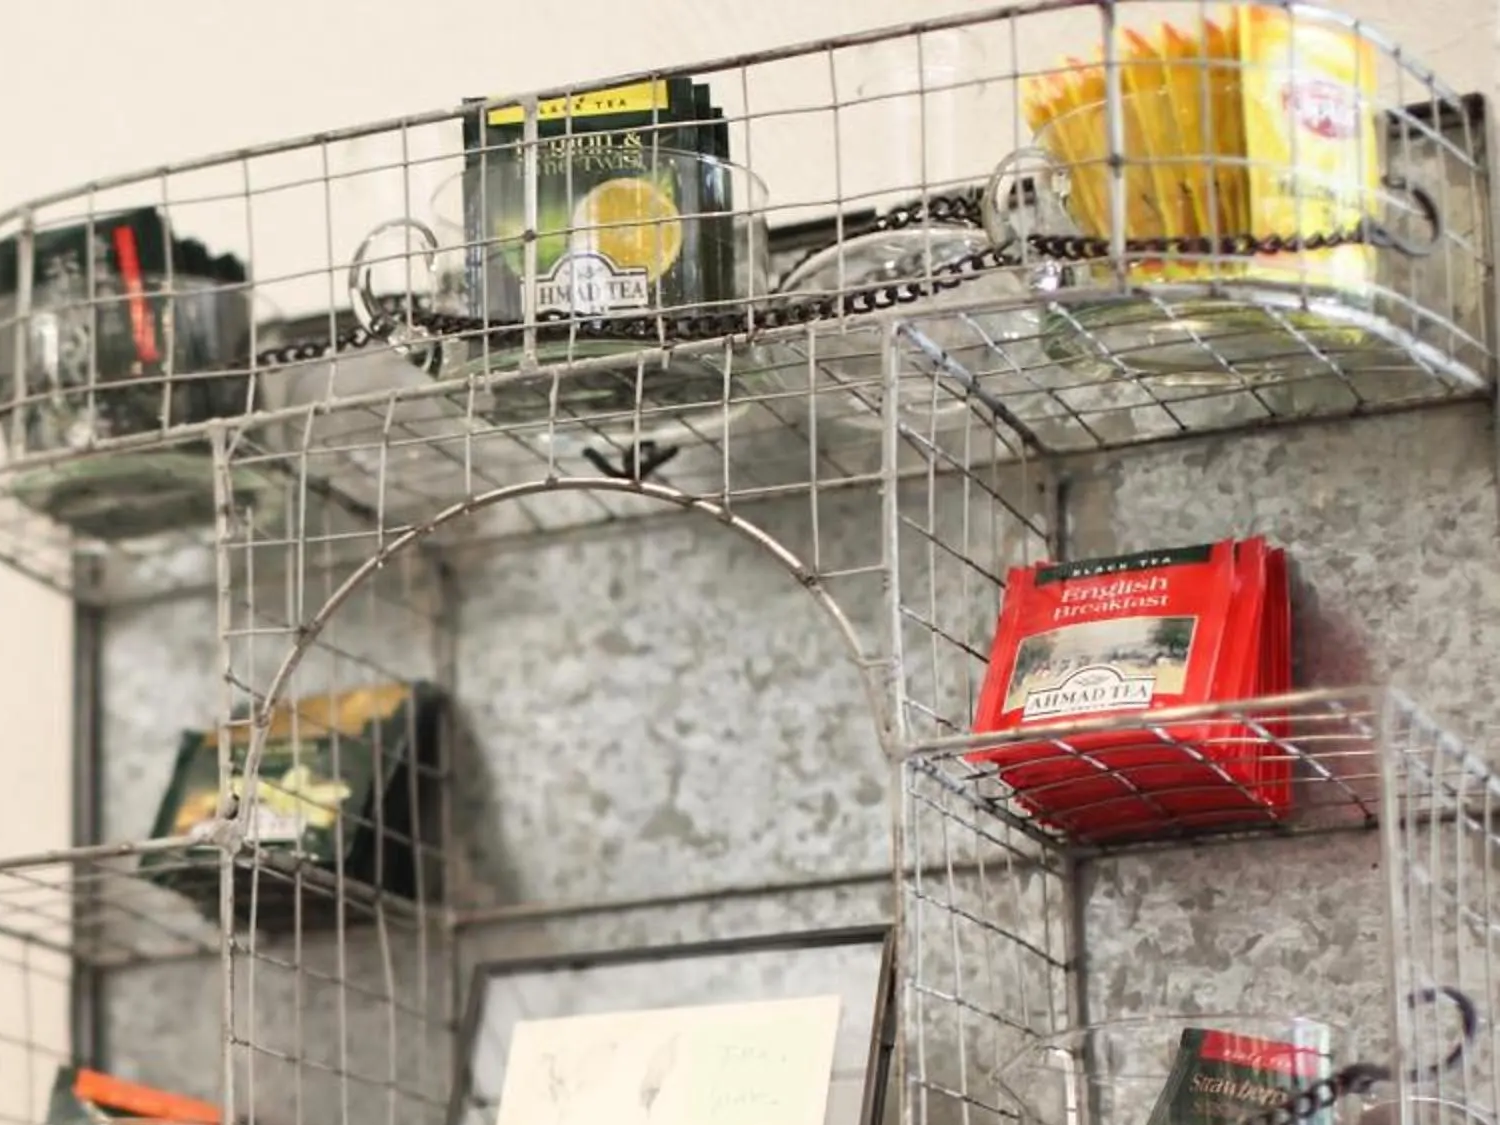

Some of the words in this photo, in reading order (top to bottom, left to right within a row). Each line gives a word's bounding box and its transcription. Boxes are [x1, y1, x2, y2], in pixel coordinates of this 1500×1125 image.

[539, 283, 600, 306] HMAD
[607, 280, 645, 300] TEA
[1072, 563, 1127, 578] BLACK
[1140, 556, 1172, 568] TEA
[1061, 576, 1169, 603] English
[1052, 595, 1169, 621] Breakfast
[1028, 688, 1106, 712] AHMAD
[1114, 684, 1148, 699] TEA
